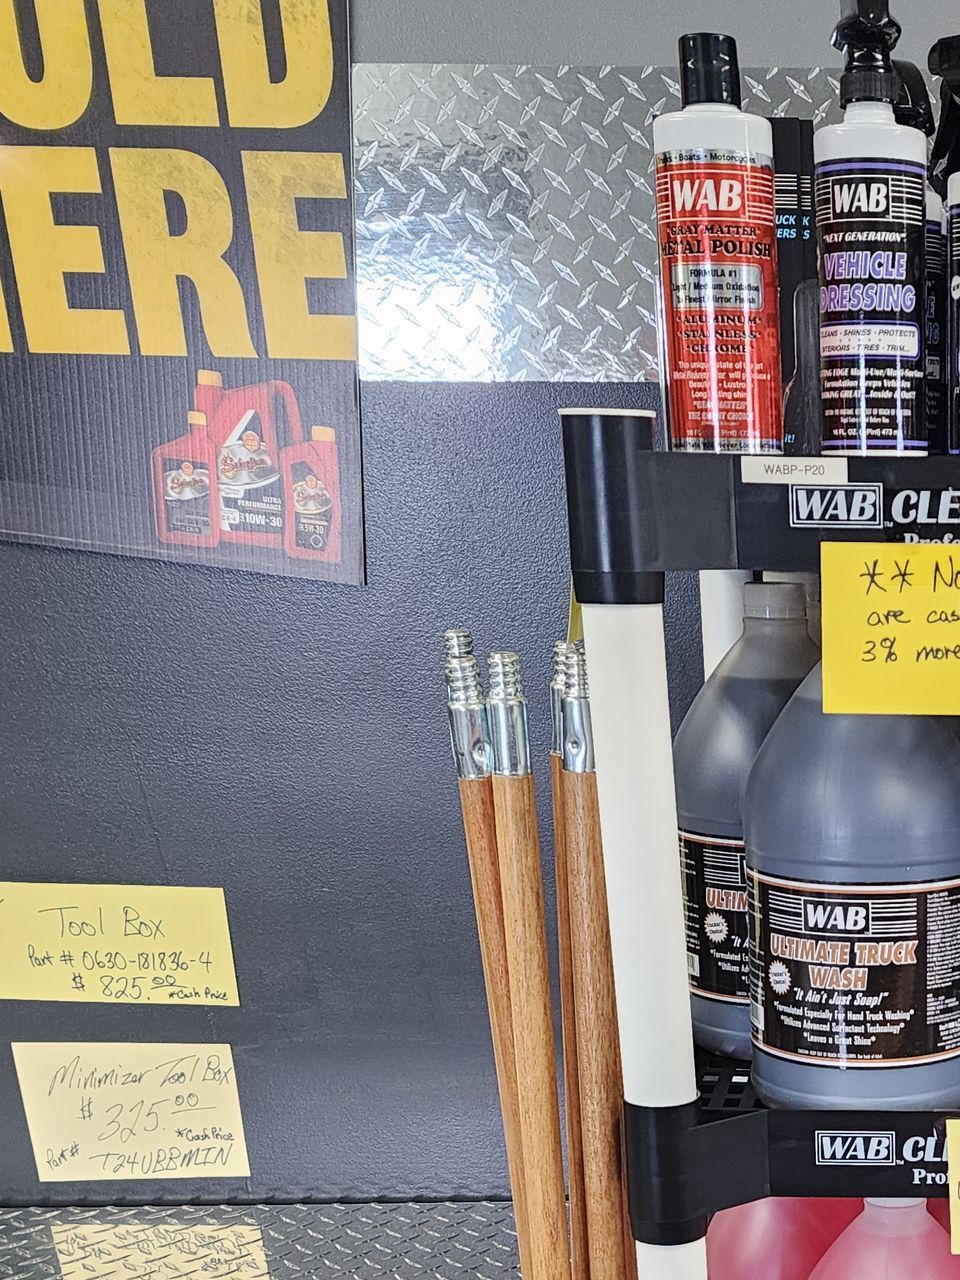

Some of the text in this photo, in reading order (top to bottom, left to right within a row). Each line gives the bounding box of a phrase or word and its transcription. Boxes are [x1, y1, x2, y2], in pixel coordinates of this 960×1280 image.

[672, 179, 742, 212] WAB
[834, 183, 887, 214] WAB
[0, 145, 358, 360] ERE
[661, 240, 772, 259] METAL POLISH
[728, 269, 737, 278] #1
[824, 251, 907, 281] VEHICLE
[820, 283, 916, 314] DRESSING
[878, 329, 916, 339] PROTECTS
[763, 463, 825, 477] WABP-P20
[237, 501, 282, 512] PERFORMANCE
[795, 490, 878, 521] WAB
[244, 514, 283, 528] 10W-30
[867, 609, 911, 626] are
[861, 640, 899, 664] 3%
[38, 905, 166, 940] Tool Box
[806, 904, 867, 931] WAB
[27, 943, 213, 972] Part # 0630-181836-4
[770, 933, 919, 967] ULTIMATE TRUCK
[71, 972, 85, 992] $
[808, 965, 869, 991] WASH
[204, 987, 229, 1001] Price
[805, 990, 850, 1006] Ain't Just
[847, 1010, 884, 1021] Hand Truck
[48, 1054, 233, 1097] Minimizer Tool Box
[76, 1096, 94, 1121] $
[819, 1136, 891, 1161] WAB
